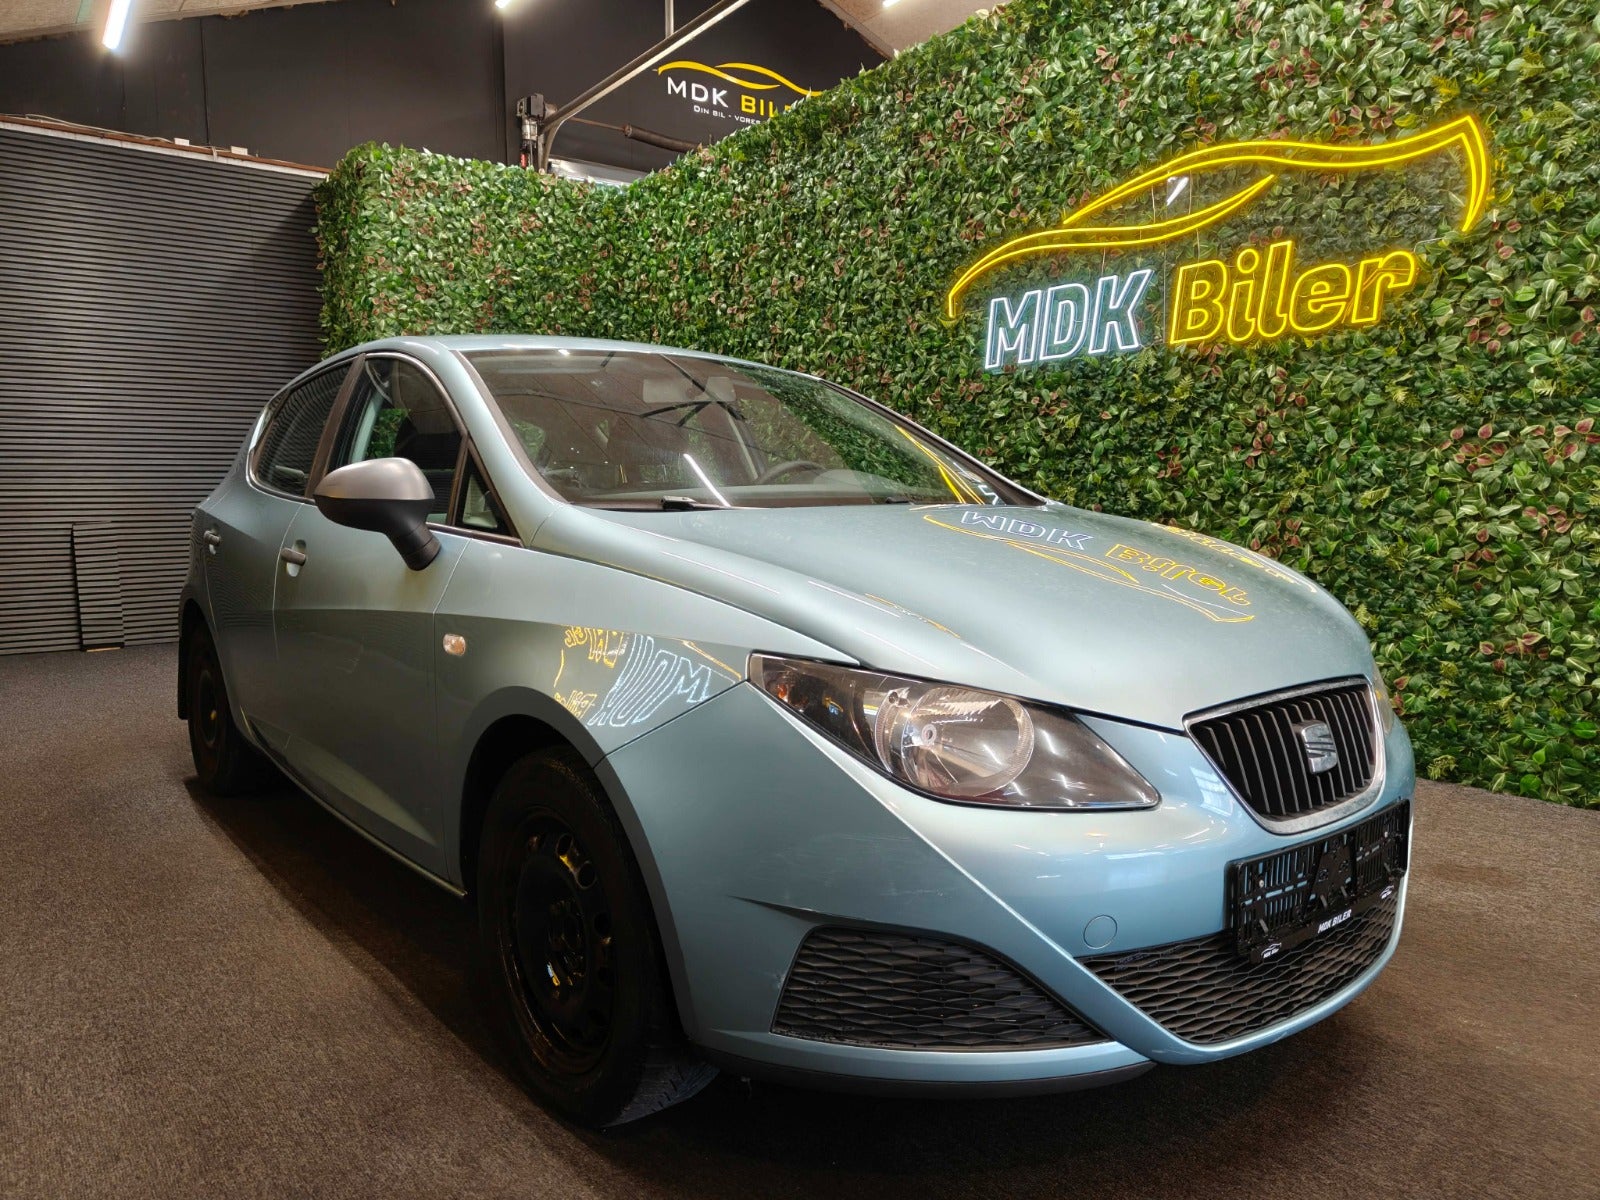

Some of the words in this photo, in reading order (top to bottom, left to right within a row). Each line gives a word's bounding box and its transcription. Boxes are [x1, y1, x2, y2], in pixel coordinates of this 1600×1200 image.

[667, 76, 729, 108] MDK
[741, 94, 791, 118] BIL
[693, 105, 709, 114] DIN
[712, 110, 726, 118] BIL
[984, 269, 1154, 371] MDK
[1170, 240, 1416, 346] Biler
